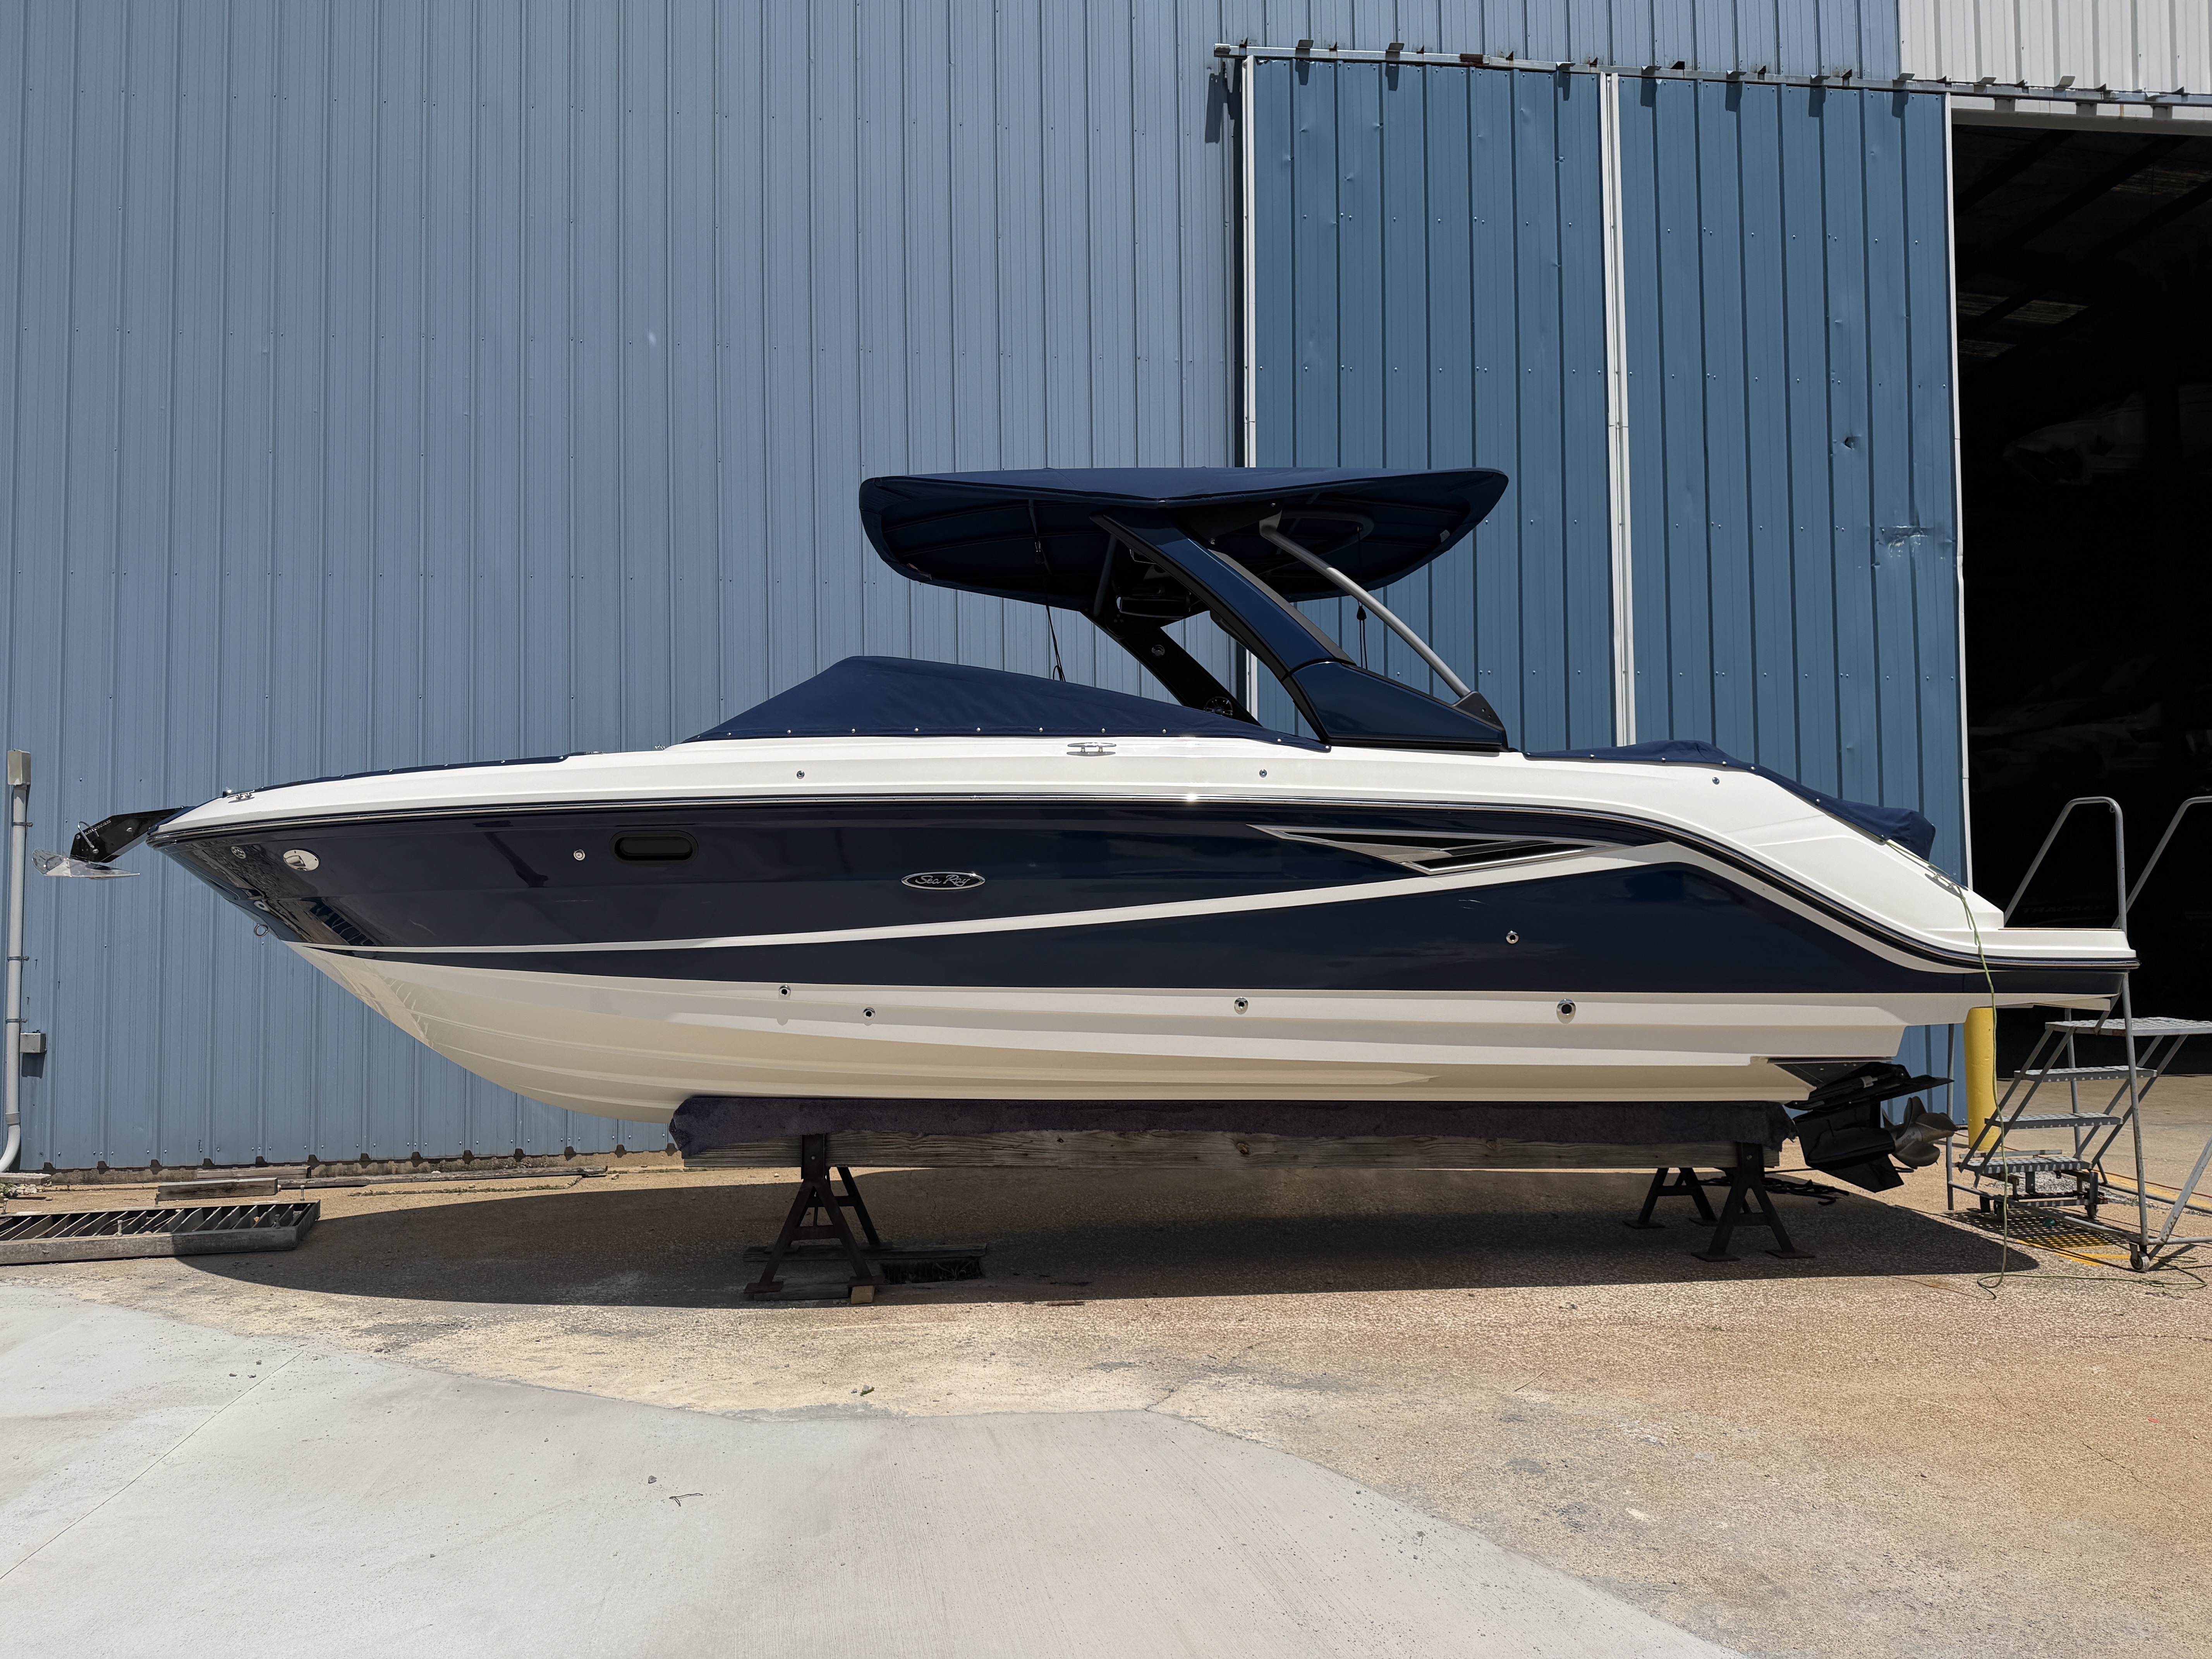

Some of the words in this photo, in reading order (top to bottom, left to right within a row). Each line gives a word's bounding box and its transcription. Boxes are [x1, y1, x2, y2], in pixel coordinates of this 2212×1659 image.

[915, 875, 941, 884] Sea
[943, 874, 970, 886] Ray
[2023, 905, 2107, 913] TRACKER
